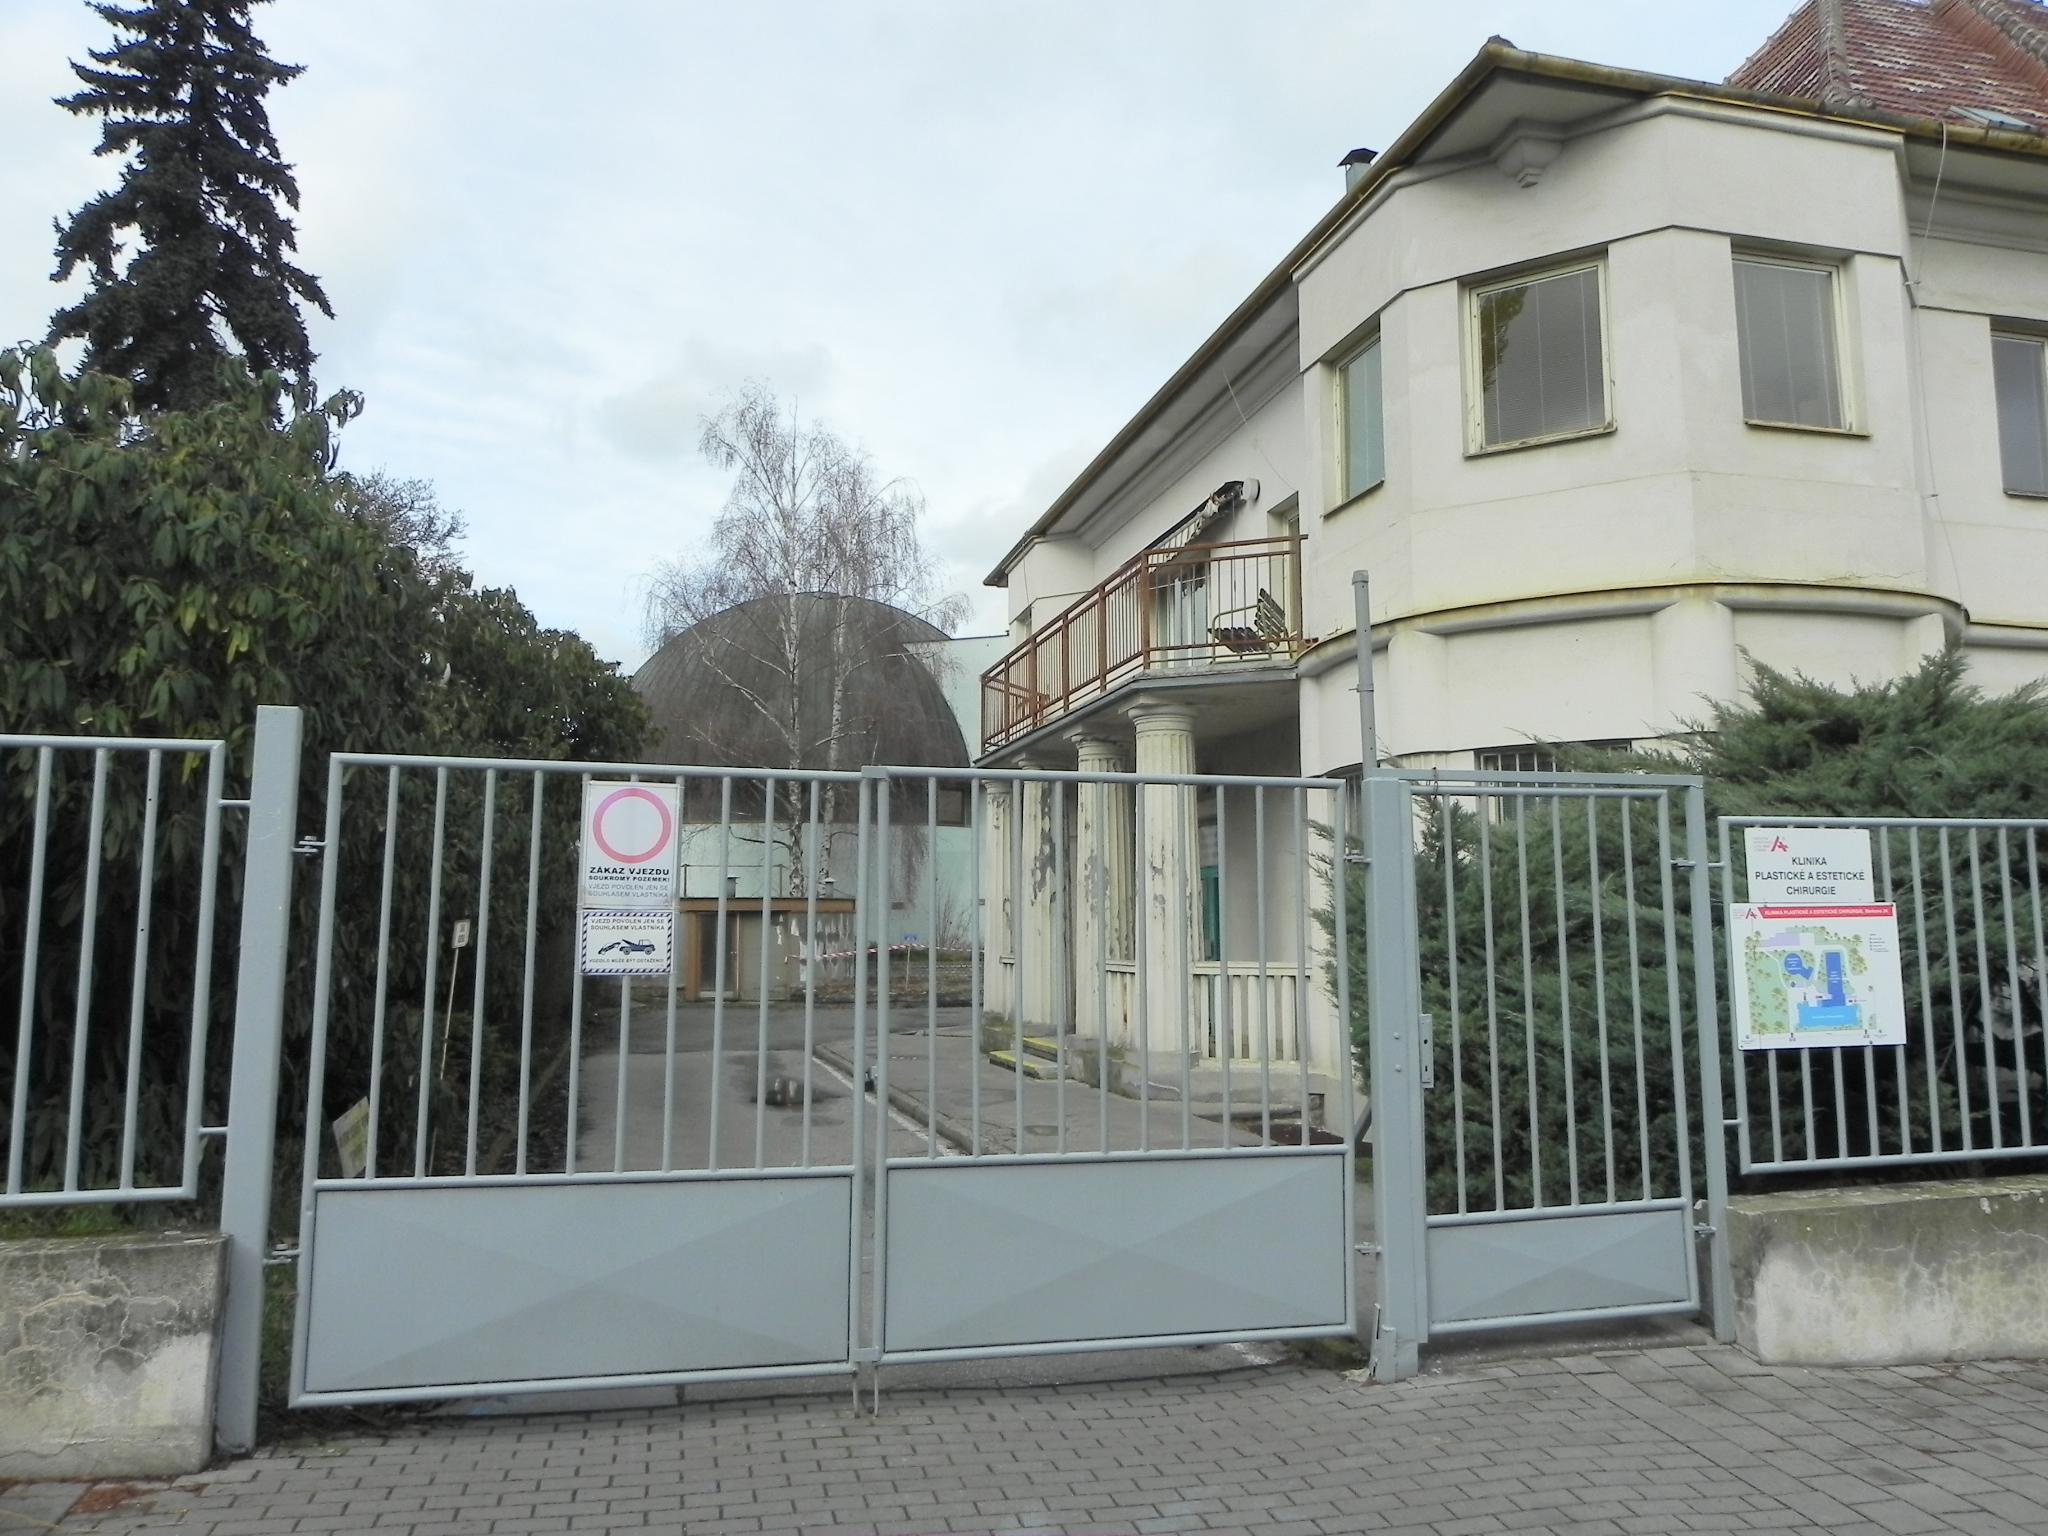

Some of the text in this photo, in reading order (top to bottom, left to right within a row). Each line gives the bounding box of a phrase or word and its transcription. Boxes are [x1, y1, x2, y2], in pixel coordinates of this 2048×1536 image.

[1791, 857, 1828, 866] KLINIKA
[589, 866, 670, 876] ZÁKAZ VJEZDU
[1755, 869, 1865, 880] PLASTICKÉ A ESTETICKÉ
[1786, 886, 1836, 895] CHIRURGIE
